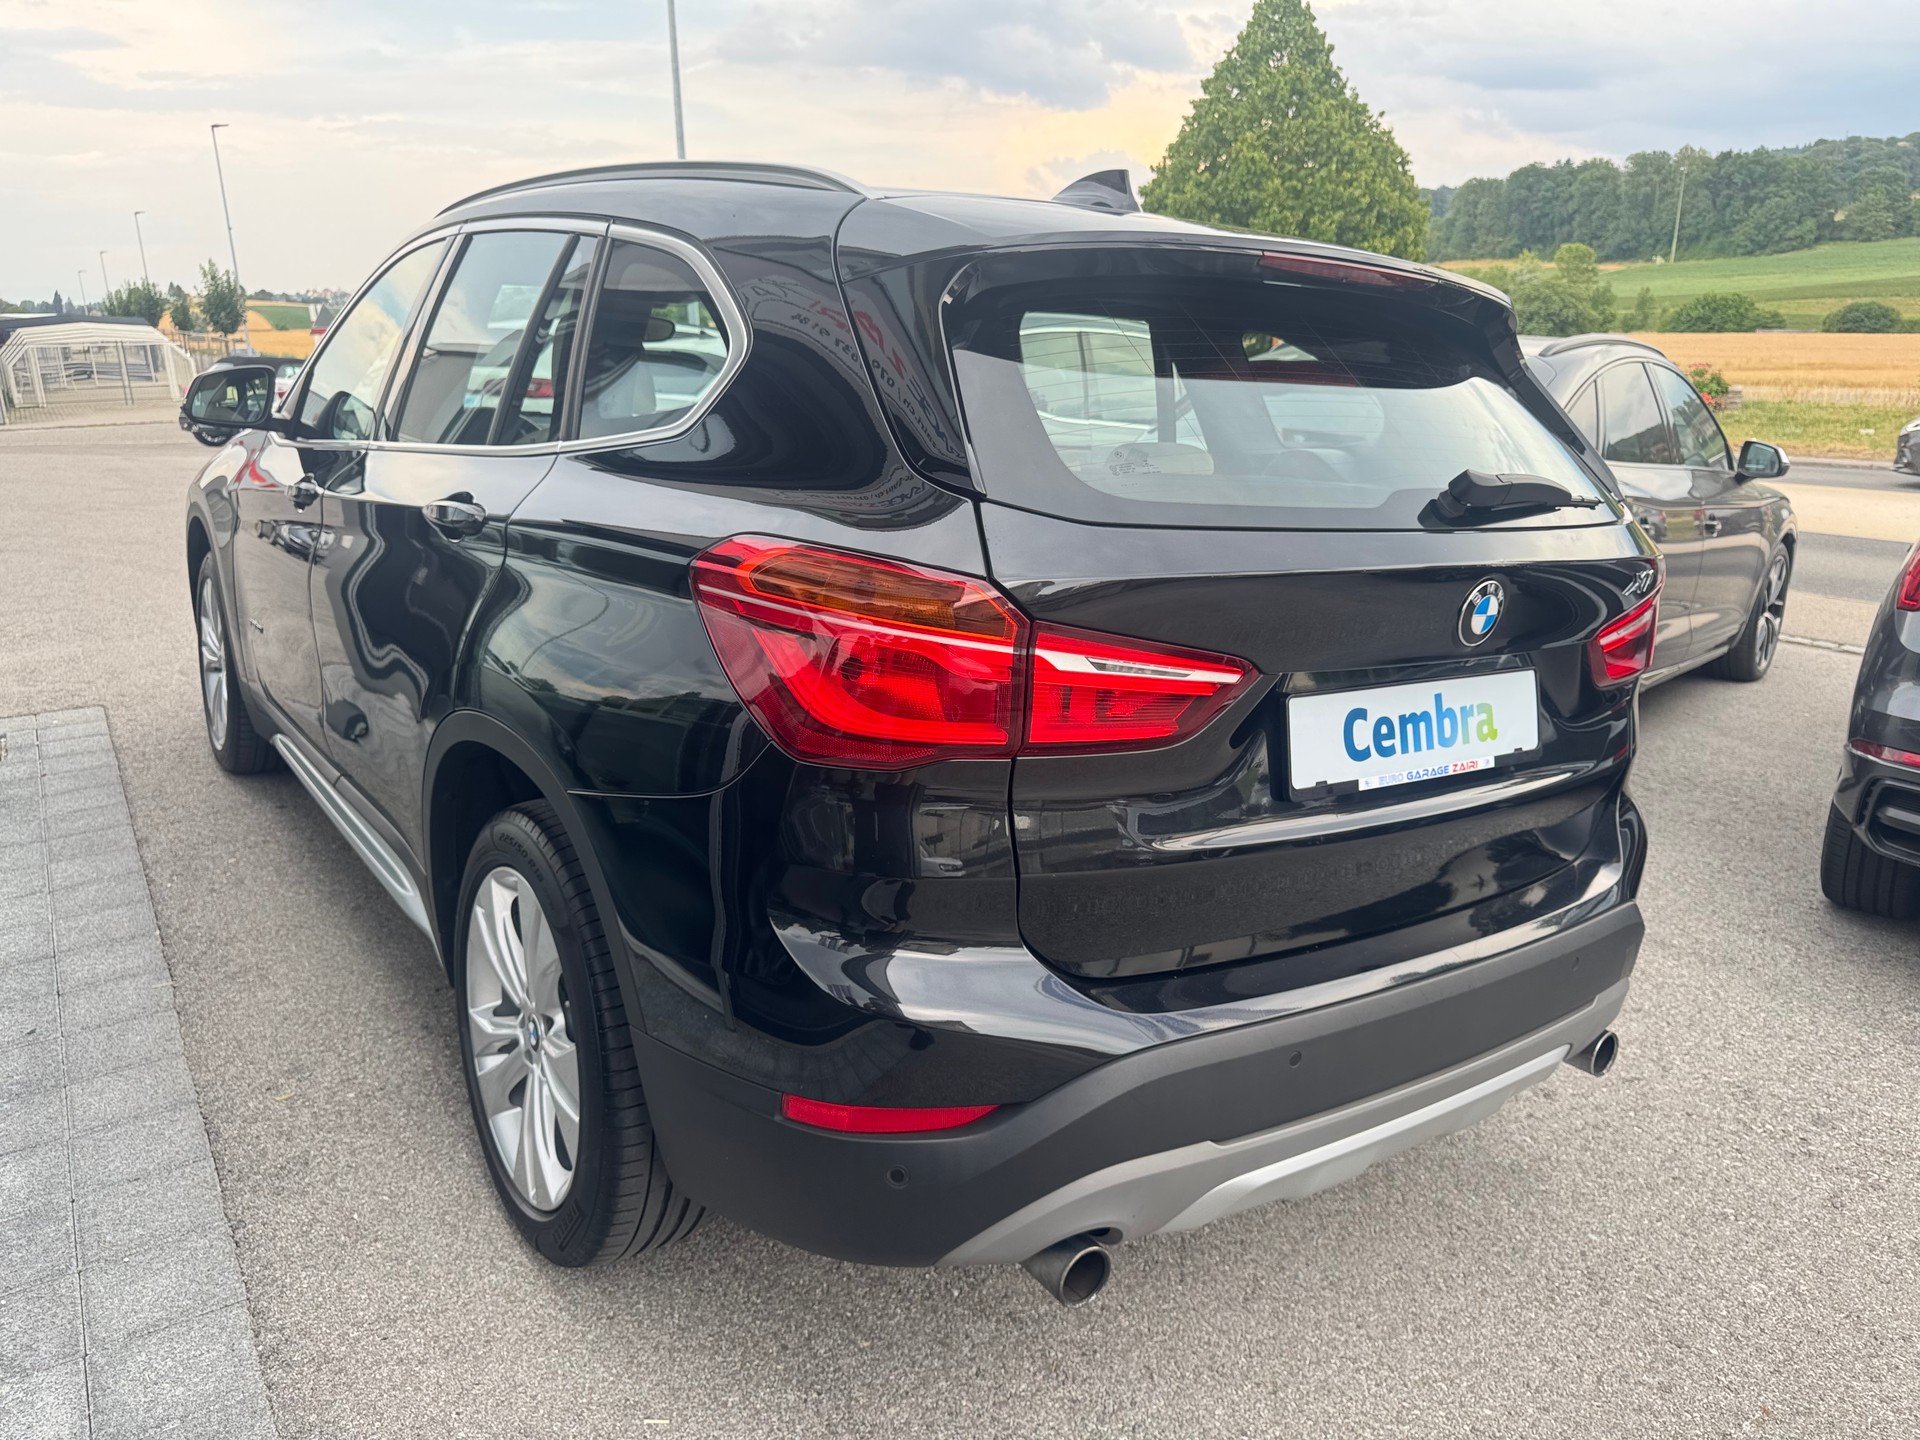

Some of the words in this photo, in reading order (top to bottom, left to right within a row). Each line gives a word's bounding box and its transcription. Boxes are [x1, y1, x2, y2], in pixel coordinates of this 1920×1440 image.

[1471, 583, 1504, 606] BMW
[1621, 569, 1654, 596] X1
[1343, 693, 1498, 762] Cembra
[1378, 773, 1405, 785] EURO
[1406, 765, 1450, 781] GARAGE
[1452, 760, 1478, 773] ZAIRI
[498, 832, 529, 858] 225/50
